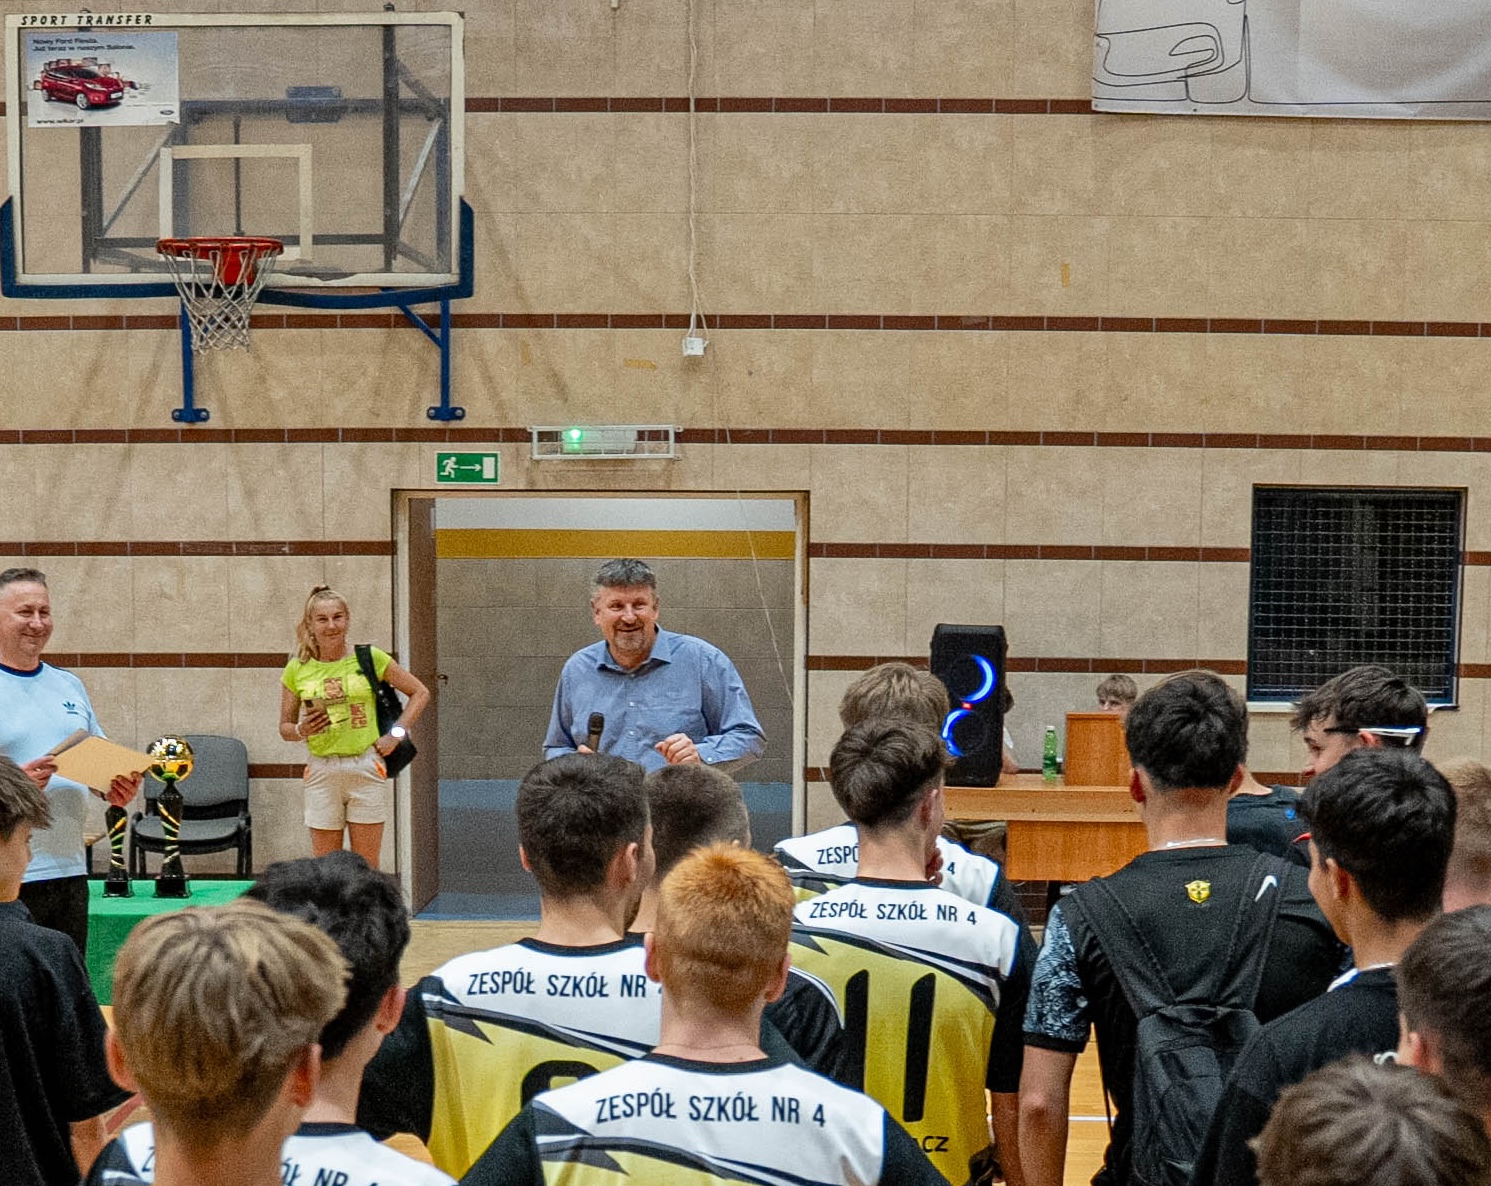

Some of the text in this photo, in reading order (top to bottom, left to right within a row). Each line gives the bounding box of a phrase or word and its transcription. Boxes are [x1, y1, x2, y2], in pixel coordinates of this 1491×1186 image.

[21, 14, 153, 26] SPORT TRANSFER
[946, 861, 956, 876] 4
[809, 899, 977, 925] ZESPÓŁ SZKÓŁ NR 4
[467, 967, 648, 999] ZESPÓŁ SZKÓŁ NR
[595, 1087, 826, 1127] ZESPÓŁ SZKÓŁ NR 4
